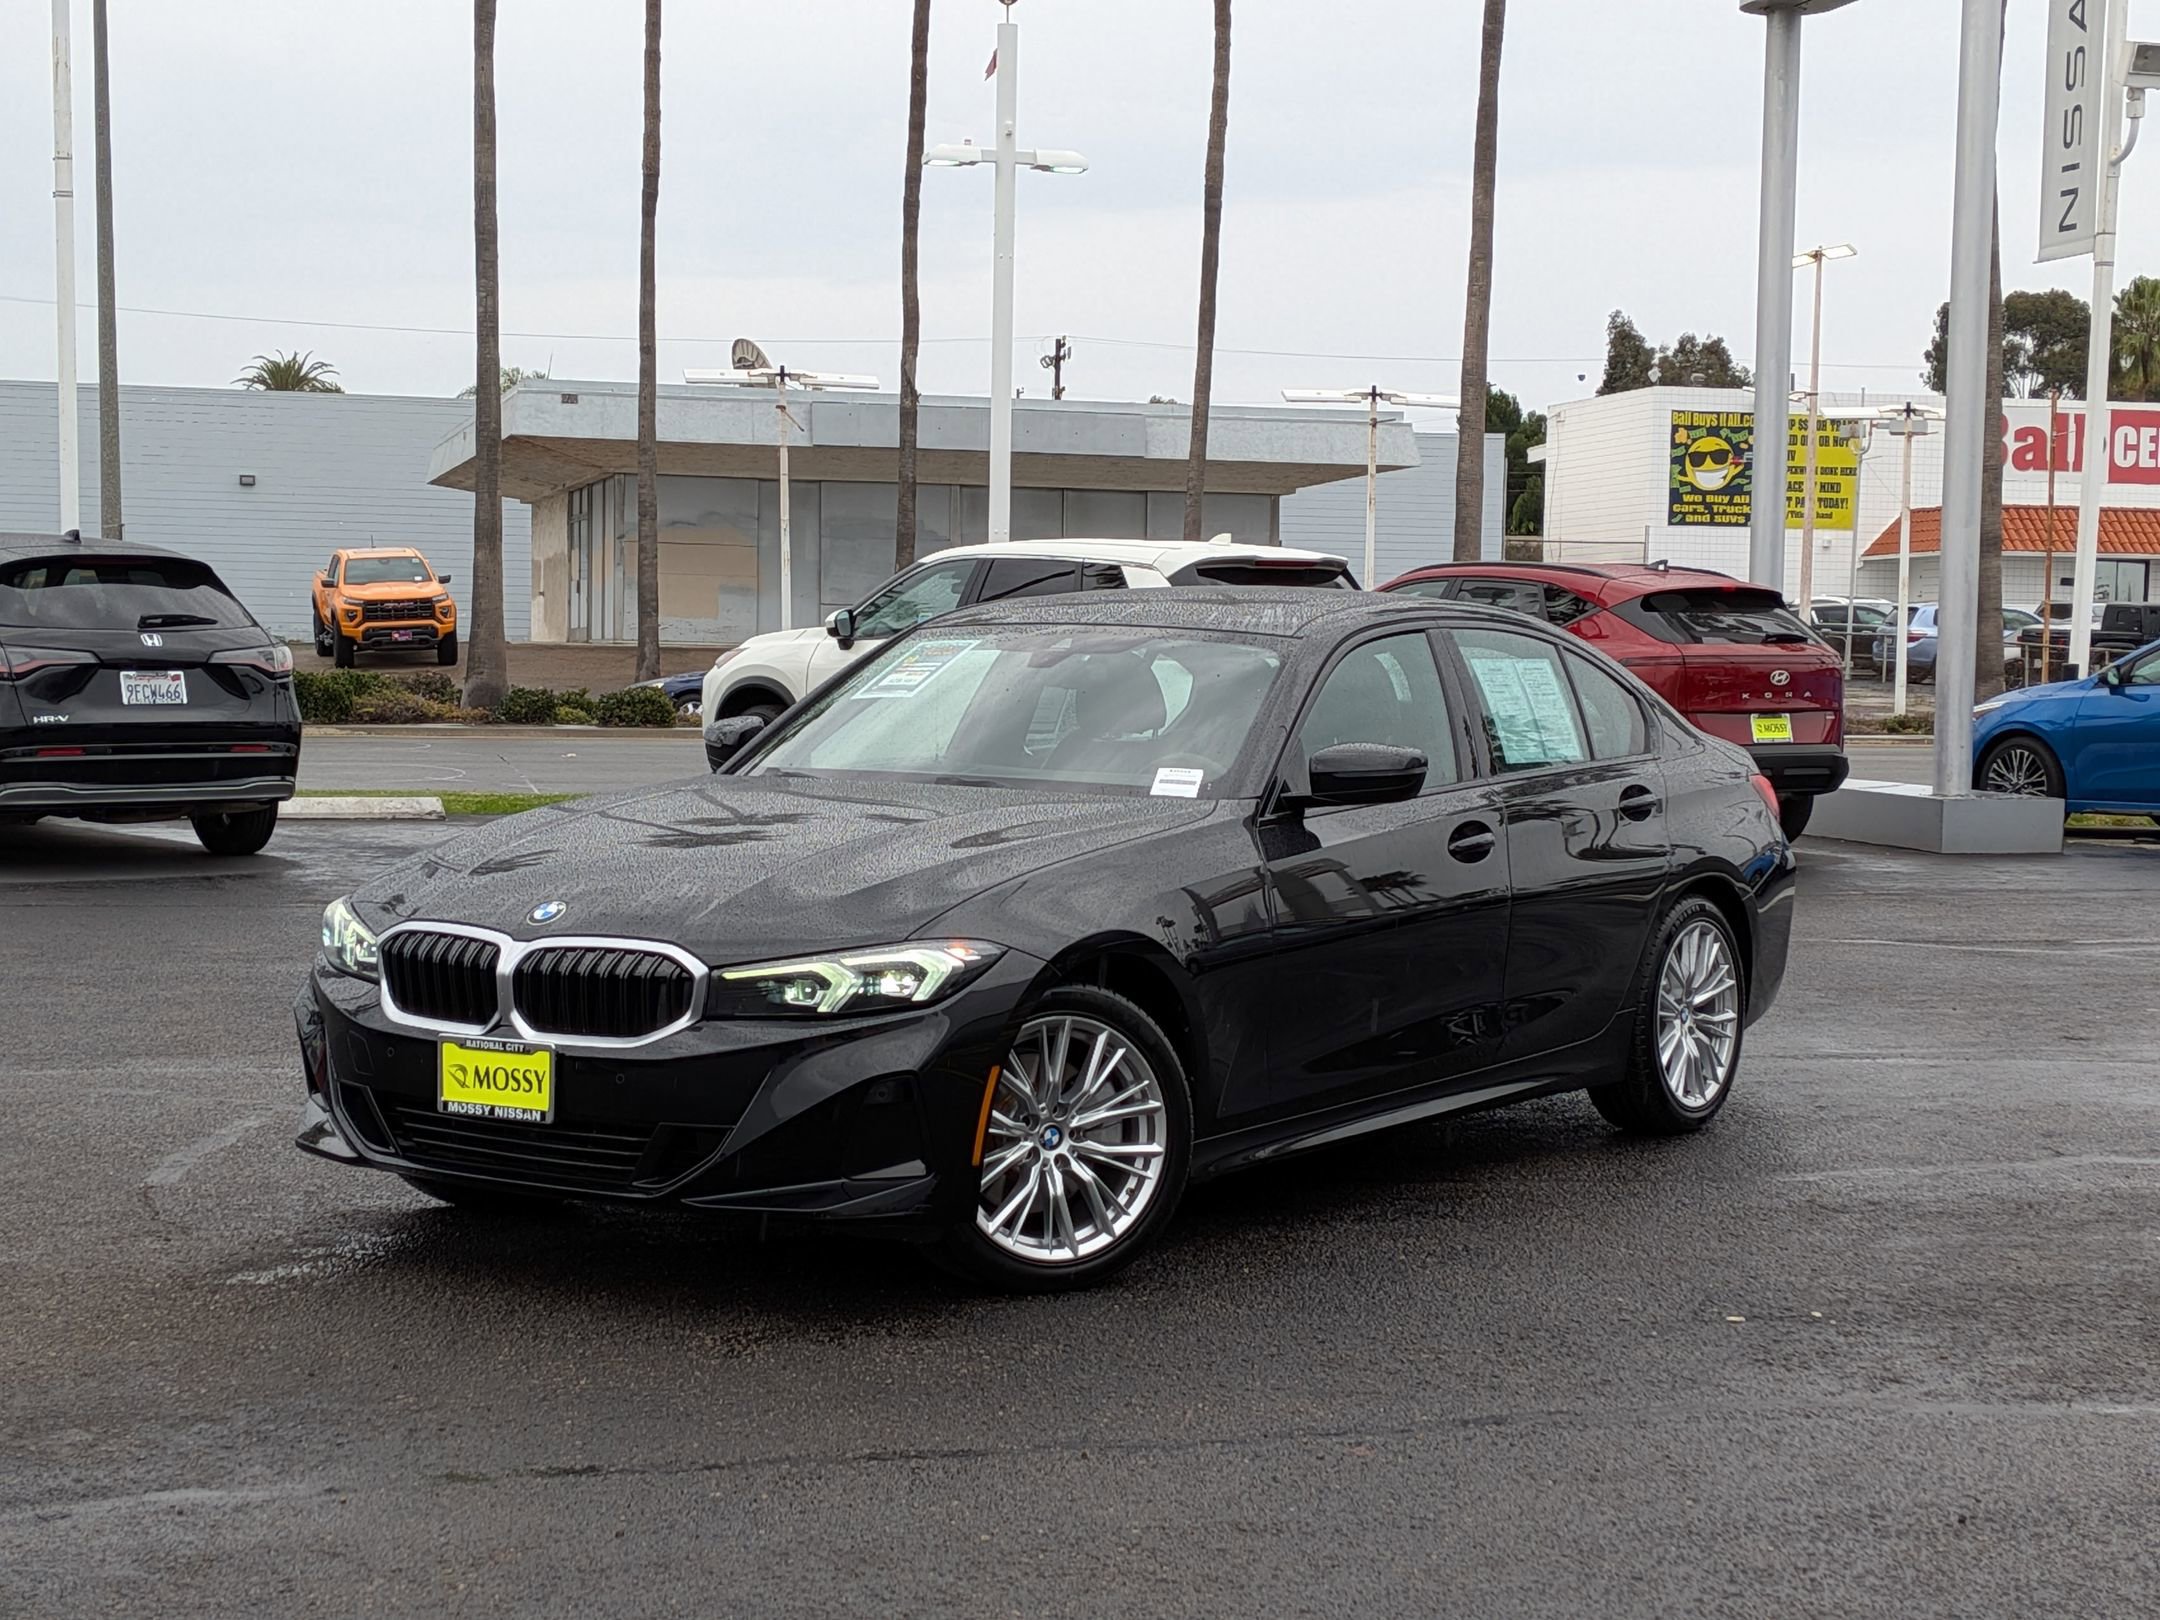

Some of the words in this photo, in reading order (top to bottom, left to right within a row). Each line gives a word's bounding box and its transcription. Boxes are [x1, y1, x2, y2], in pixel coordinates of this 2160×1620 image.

[1672, 411, 1692, 425] Ball
[1693, 412, 1718, 428] Buys
[2001, 412, 2087, 472] all
[2113, 425, 2160, 468] CE
[1786, 480, 1804, 493] ACE
[1705, 494, 1731, 503] Buy
[1672, 504, 1709, 513] Cars,
[1685, 513, 1711, 523] and
[1741, 690, 1813, 700] KONA
[33, 715, 69, 724] HR-V
[466, 1039, 504, 1051] NATIONAL
[505, 1043, 525, 1052] CITY
[472, 1065, 547, 1094] MOSSY
[447, 1101, 492, 1116] MOSSY
[494, 1106, 541, 1122] NISSAN
